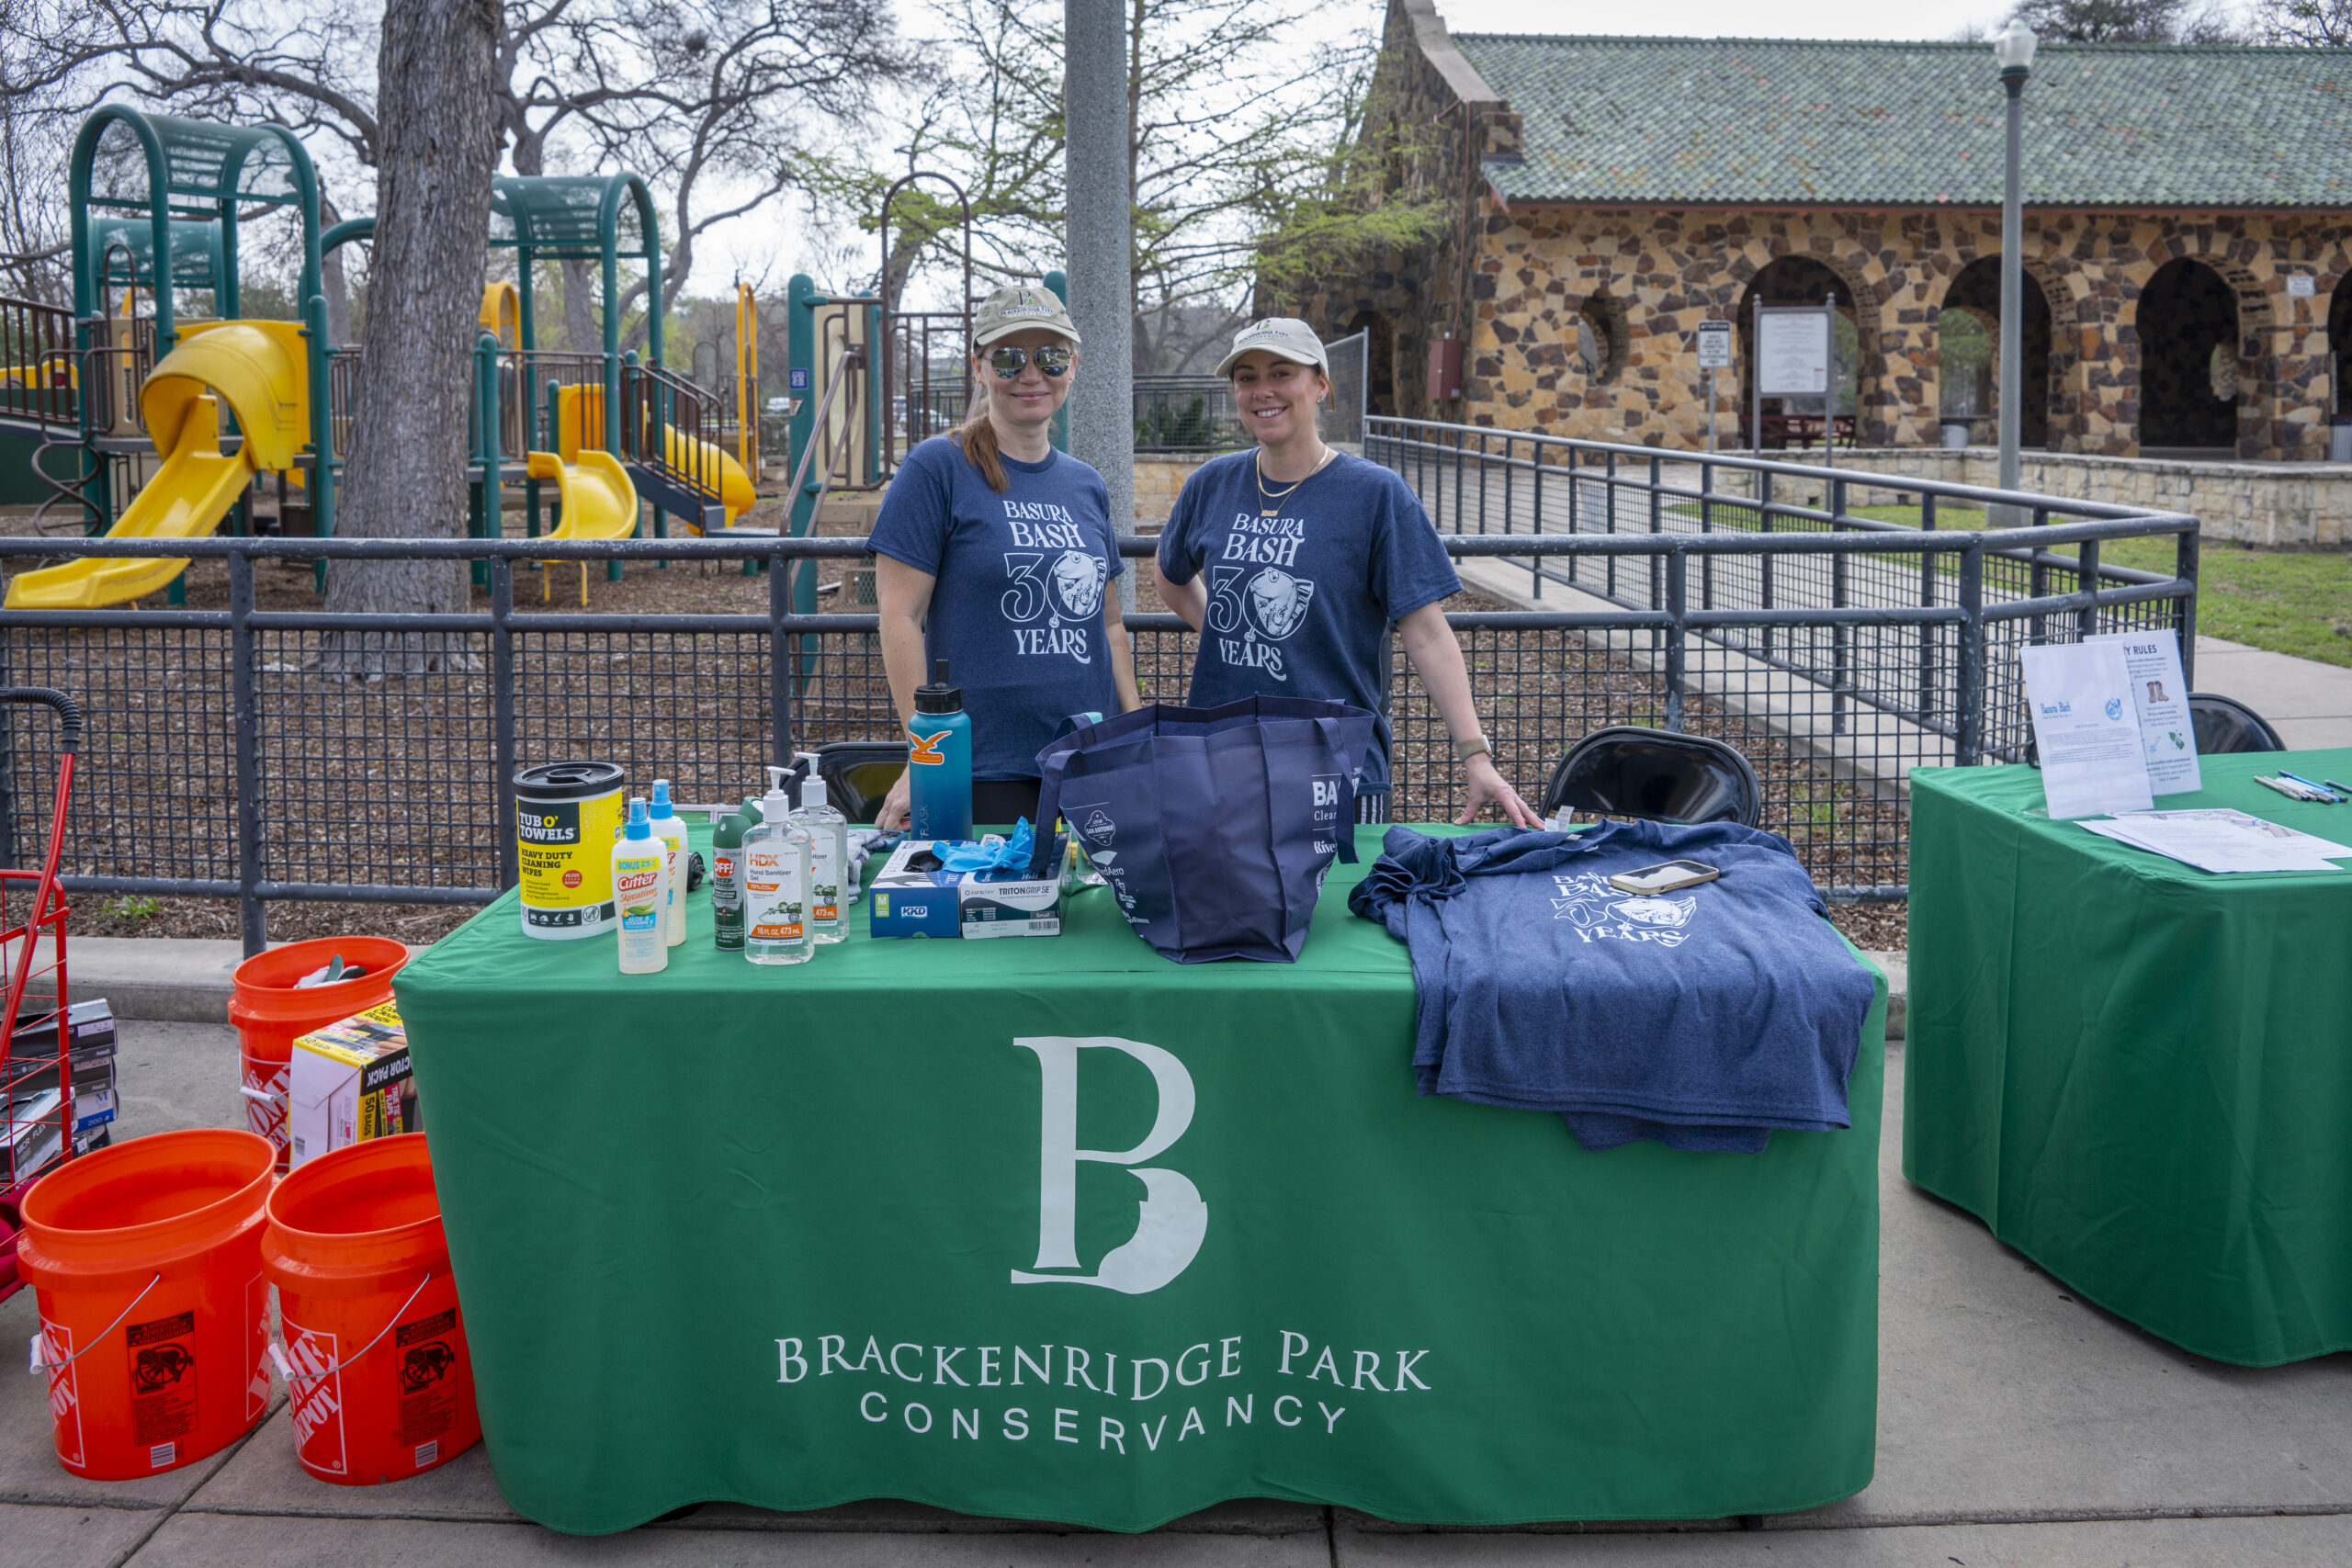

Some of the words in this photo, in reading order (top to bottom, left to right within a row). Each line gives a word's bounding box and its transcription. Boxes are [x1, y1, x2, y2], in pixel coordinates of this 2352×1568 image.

[1002, 501, 1075, 525] BASURA
[1232, 513, 1305, 538] BASURA
[1009, 522, 1087, 547] BASH
[1222, 534, 1302, 567] BASH
[1013, 628, 1091, 664] YEARS
[2133, 645, 2157, 655] RULES
[1219, 637, 1286, 682] YEARS
[519, 812, 542, 827] TUB
[543, 816, 558, 828] O'
[519, 826, 574, 840] TOWELS
[521, 848, 543, 859] HEAVY
[545, 852, 572, 860] DUTY
[750, 853, 779, 866] HDX
[522, 857, 561, 869] CLEANING
[522, 866, 543, 876] WIPES
[618, 861, 640, 871] BONUS
[640, 860, 651, 868] 25
[714, 861, 735, 874] OFF!
[618, 873, 657, 891] Cutter
[1041, 886, 1050, 894] SE
[877, 897, 887, 905] M
[757, 927, 764, 935] 16
[1573, 926, 1690, 947] YEARS
[367, 1065, 389, 1087] PACK
[95, 1091, 108, 1103] M
[365, 1096, 375, 1115] 50
[87, 1116, 103, 1126] 200
[364, 1113, 372, 1136] BAGS
[1011, 1035, 1208, 1295] B
[775, 1335, 1242, 1402] BRACKENRIDGE
[1278, 1330, 1431, 1392] PARK
[860, 1391, 1346, 1455] CONSERVANCY
